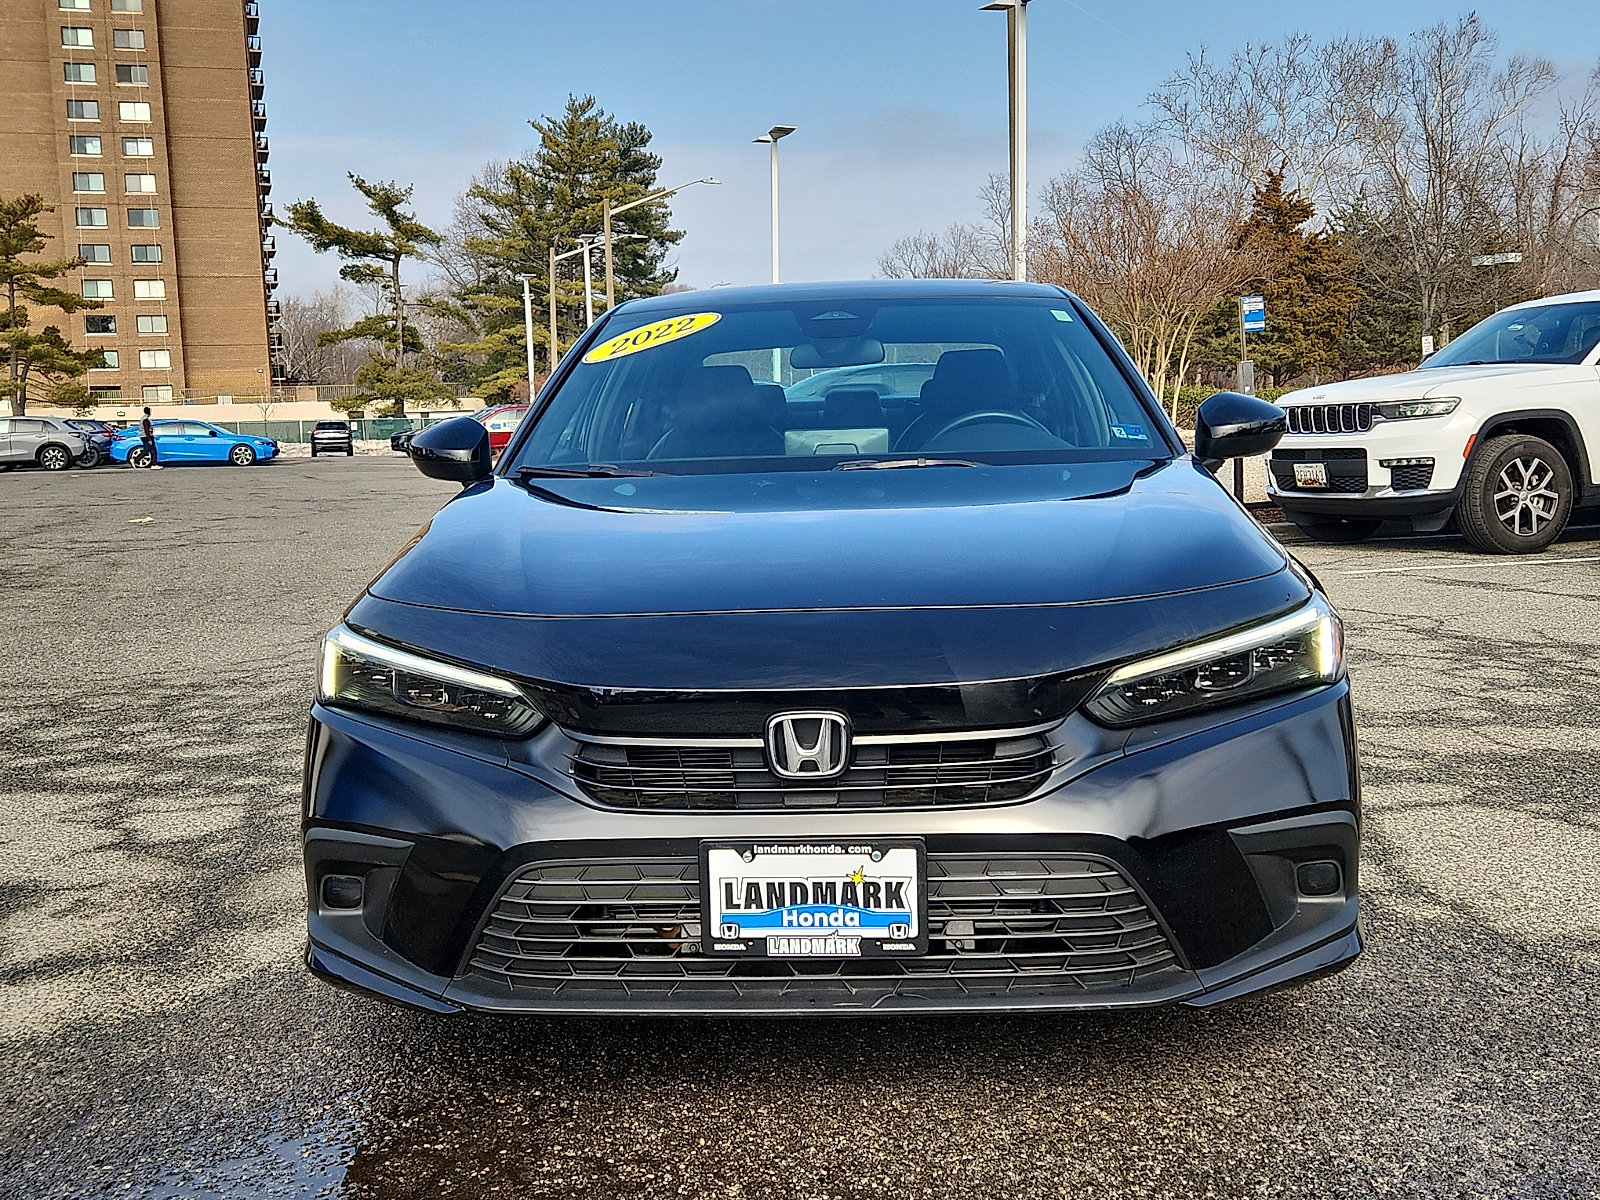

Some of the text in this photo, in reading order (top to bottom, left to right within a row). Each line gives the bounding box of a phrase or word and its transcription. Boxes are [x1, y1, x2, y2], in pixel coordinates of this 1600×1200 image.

[609, 317, 696, 355] 2022
[724, 881, 907, 910] LANDMARK
[782, 908, 860, 928] Honda
[769, 937, 860, 955] LANDMARK
